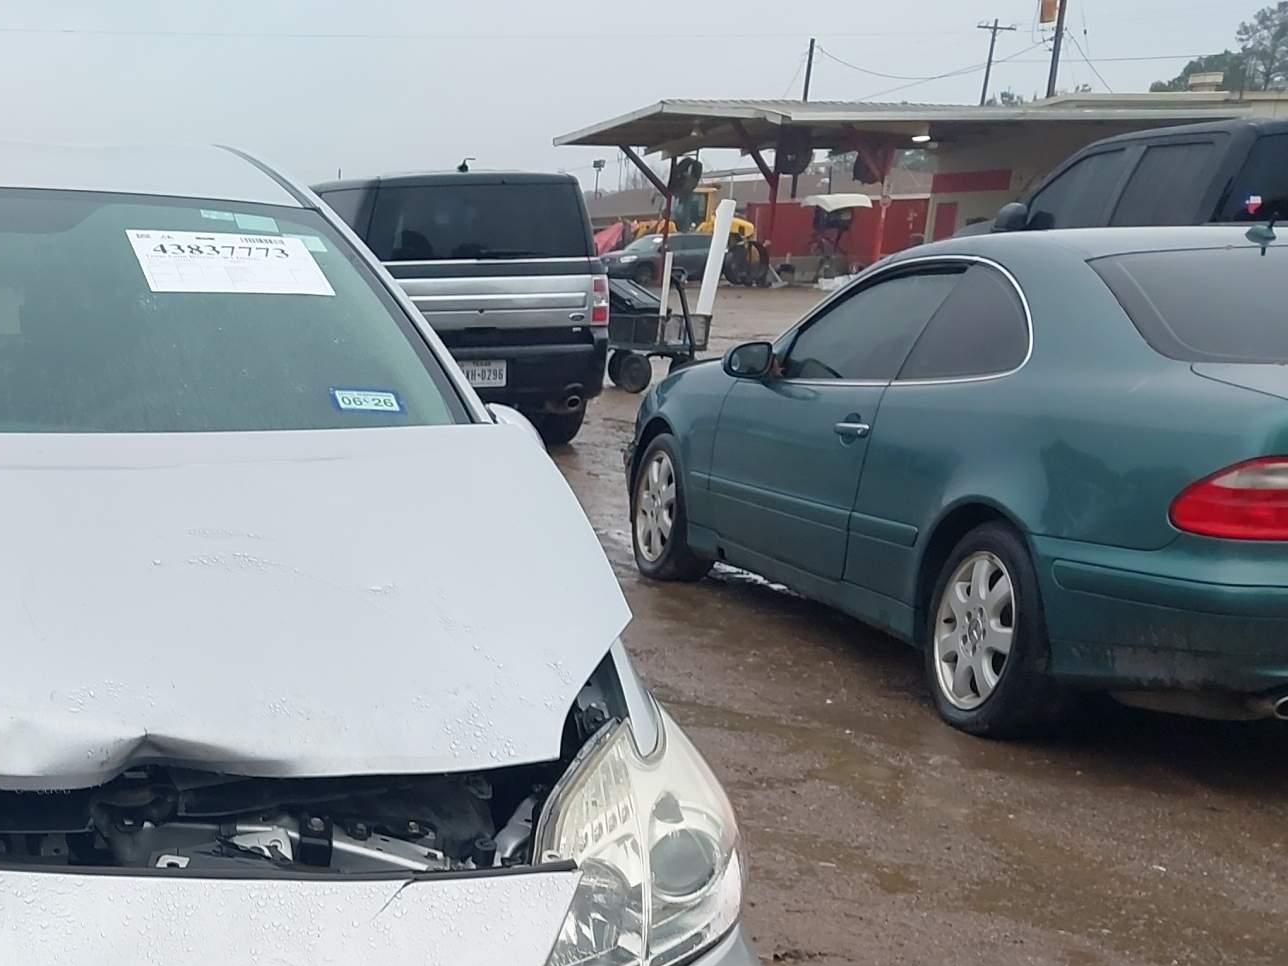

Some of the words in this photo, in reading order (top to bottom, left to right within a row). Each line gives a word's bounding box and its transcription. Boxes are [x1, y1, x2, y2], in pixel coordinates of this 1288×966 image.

[152, 243, 289, 258] 43837773
[341, 396, 363, 406] 06
[371, 398, 394, 407] 26
